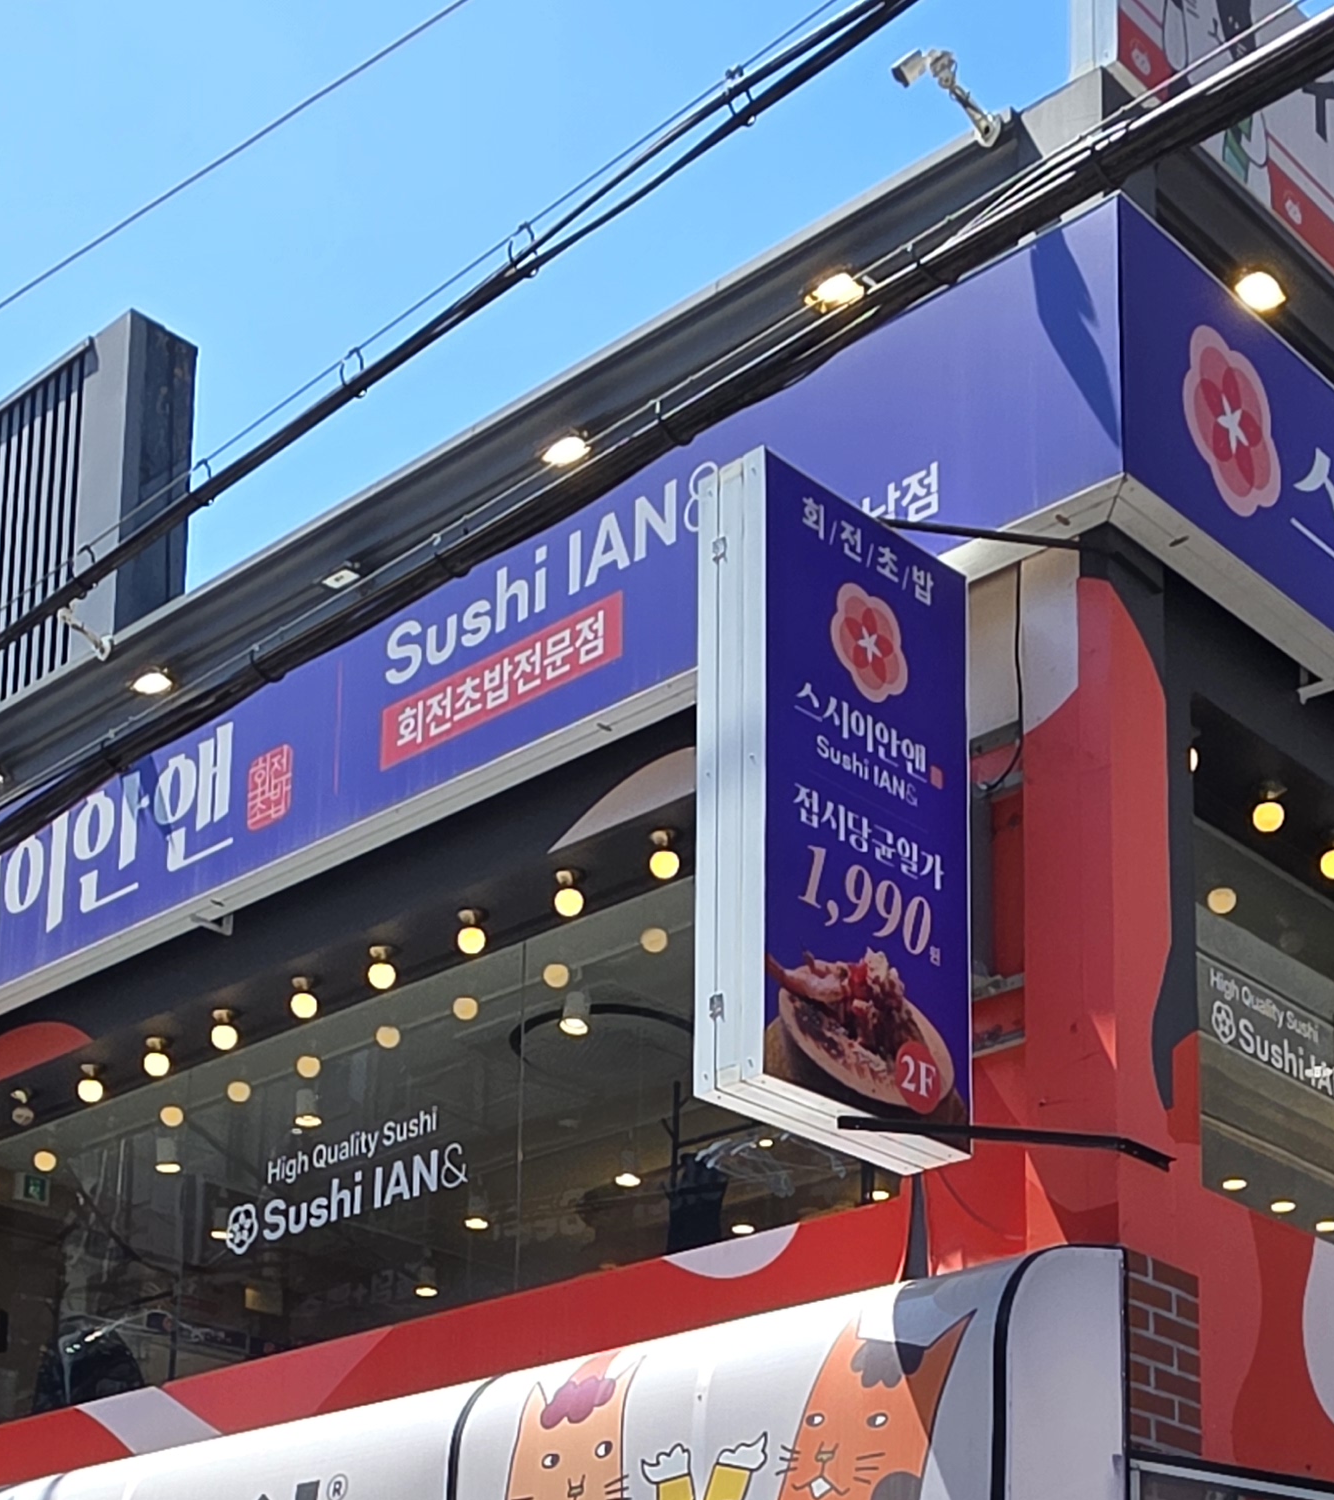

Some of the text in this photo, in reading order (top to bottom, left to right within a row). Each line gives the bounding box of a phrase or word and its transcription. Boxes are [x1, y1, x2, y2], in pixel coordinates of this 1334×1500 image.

[384, 545, 548, 685] Sushi
[396, 610, 606, 746] 회전초밥전문점
[794, 682, 927, 783] 스시이안앤
[816, 735, 869, 782] Sushi
[1210, 968, 1319, 1043] High Quality Sushi
[899, 1055, 937, 1097] 2F
[1238, 1018, 1305, 1081] Sushi
[267, 1106, 438, 1185] High Quality Sushi
[263, 1169, 362, 1241] Sushi
